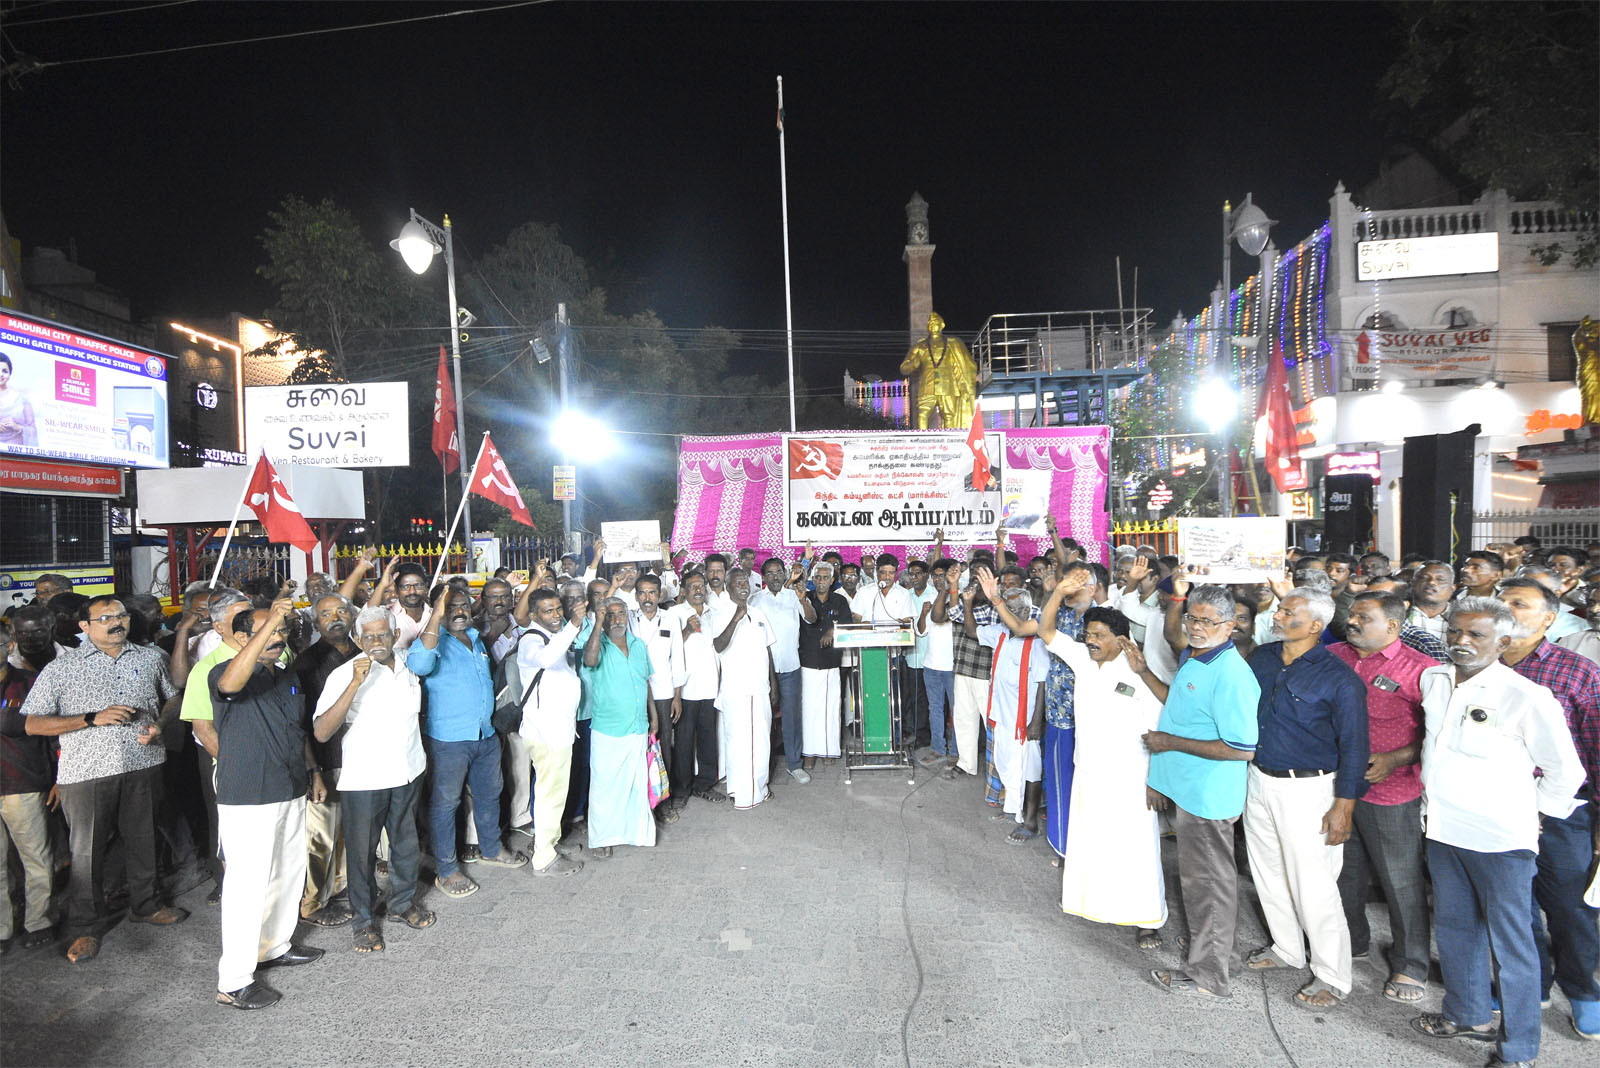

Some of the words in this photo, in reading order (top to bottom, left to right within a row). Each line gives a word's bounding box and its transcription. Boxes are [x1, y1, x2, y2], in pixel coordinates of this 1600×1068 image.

[1361, 260, 1409, 274] Suvai
[8, 319, 50, 337] MADURAI
[52, 331, 71, 342] CITY
[75, 337, 108, 352] TRAFFIC
[109, 346, 135, 359] POLICE
[1381, 333, 1446, 347] SUVAI
[1454, 328, 1492, 345] VEG
[1, 332, 30, 345] SOUTH
[31, 339, 52, 351] GATE
[54, 345, 85, 360] TRAFFIC
[87, 353, 111, 365] POLICE
[113, 359, 141, 373] STATION
[62, 383, 91, 396] SMILE
[286, 388, 366, 408] சுவை
[288, 424, 366, 450] Suvai
[7, 445, 23, 454] WAY
[25, 447, 34, 455] TO
[35, 448, 67, 458] SIL-WEAR
[69, 452, 88, 461] SMILE
[90, 455, 127, 465] SHOWROOM
[292, 455, 338, 465] Restaurant
[342, 456, 349, 464] &
[353, 454, 384, 464] Bakery
[11, 470, 40, 481] மாநகர
[42, 471, 94, 486] போக்குவரத்து
[95, 475, 117, 485] காவல்
[888, 491, 903, 500] கட்சி
[796, 502, 873, 528] கண்டன
[878, 501, 995, 530] ஆர்ப்பாட்டம்
